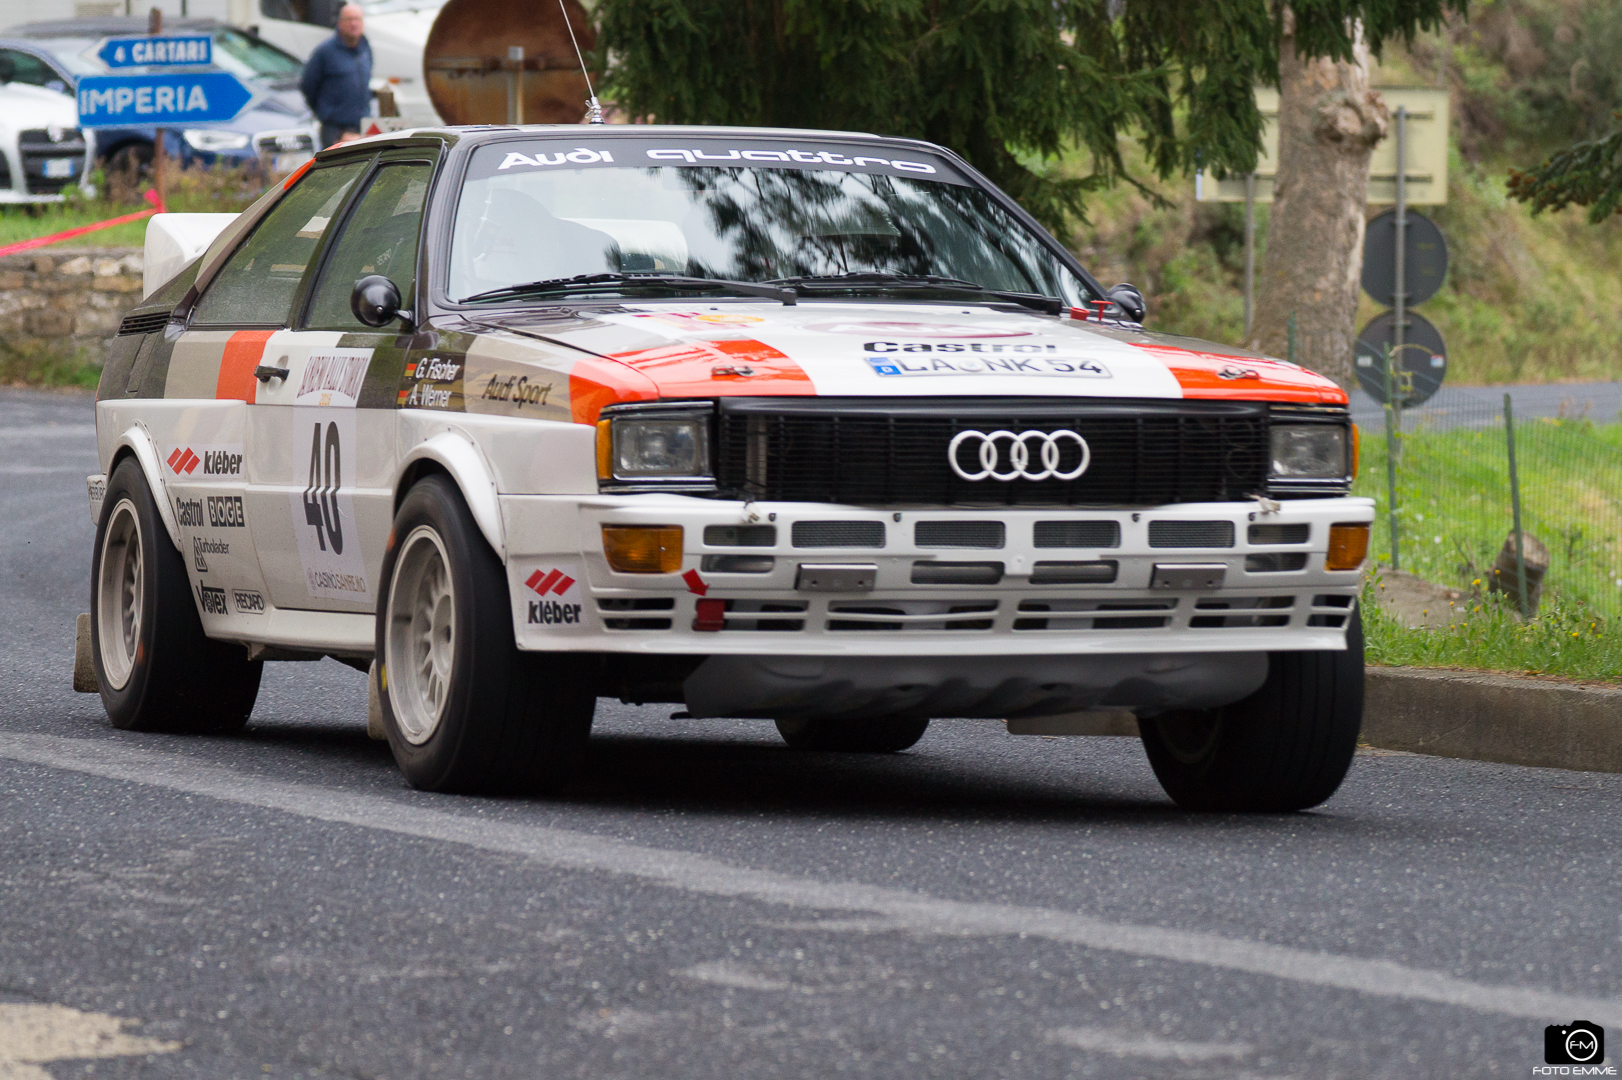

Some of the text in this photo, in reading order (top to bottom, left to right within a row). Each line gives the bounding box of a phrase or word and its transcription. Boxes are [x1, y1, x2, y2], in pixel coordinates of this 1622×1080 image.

[131, 40, 208, 63] CARTARI
[80, 85, 209, 115] IMPERIA
[497, 148, 937, 174] Audi quattro
[863, 341, 1058, 353] Castrol
[426, 357, 461, 381] Fischer
[894, 358, 957, 372] LA
[979, 358, 1042, 372] NK
[1045, 358, 1102, 374] 54
[420, 384, 453, 408] Werner
[481, 374, 552, 409] Audi Sport
[203, 450, 243, 475] kléber
[303, 421, 343, 556] 40
[176, 496, 244, 527] Castrol BOGE
[234, 592, 265, 611] RECARO
[528, 600, 581, 625] kléber
